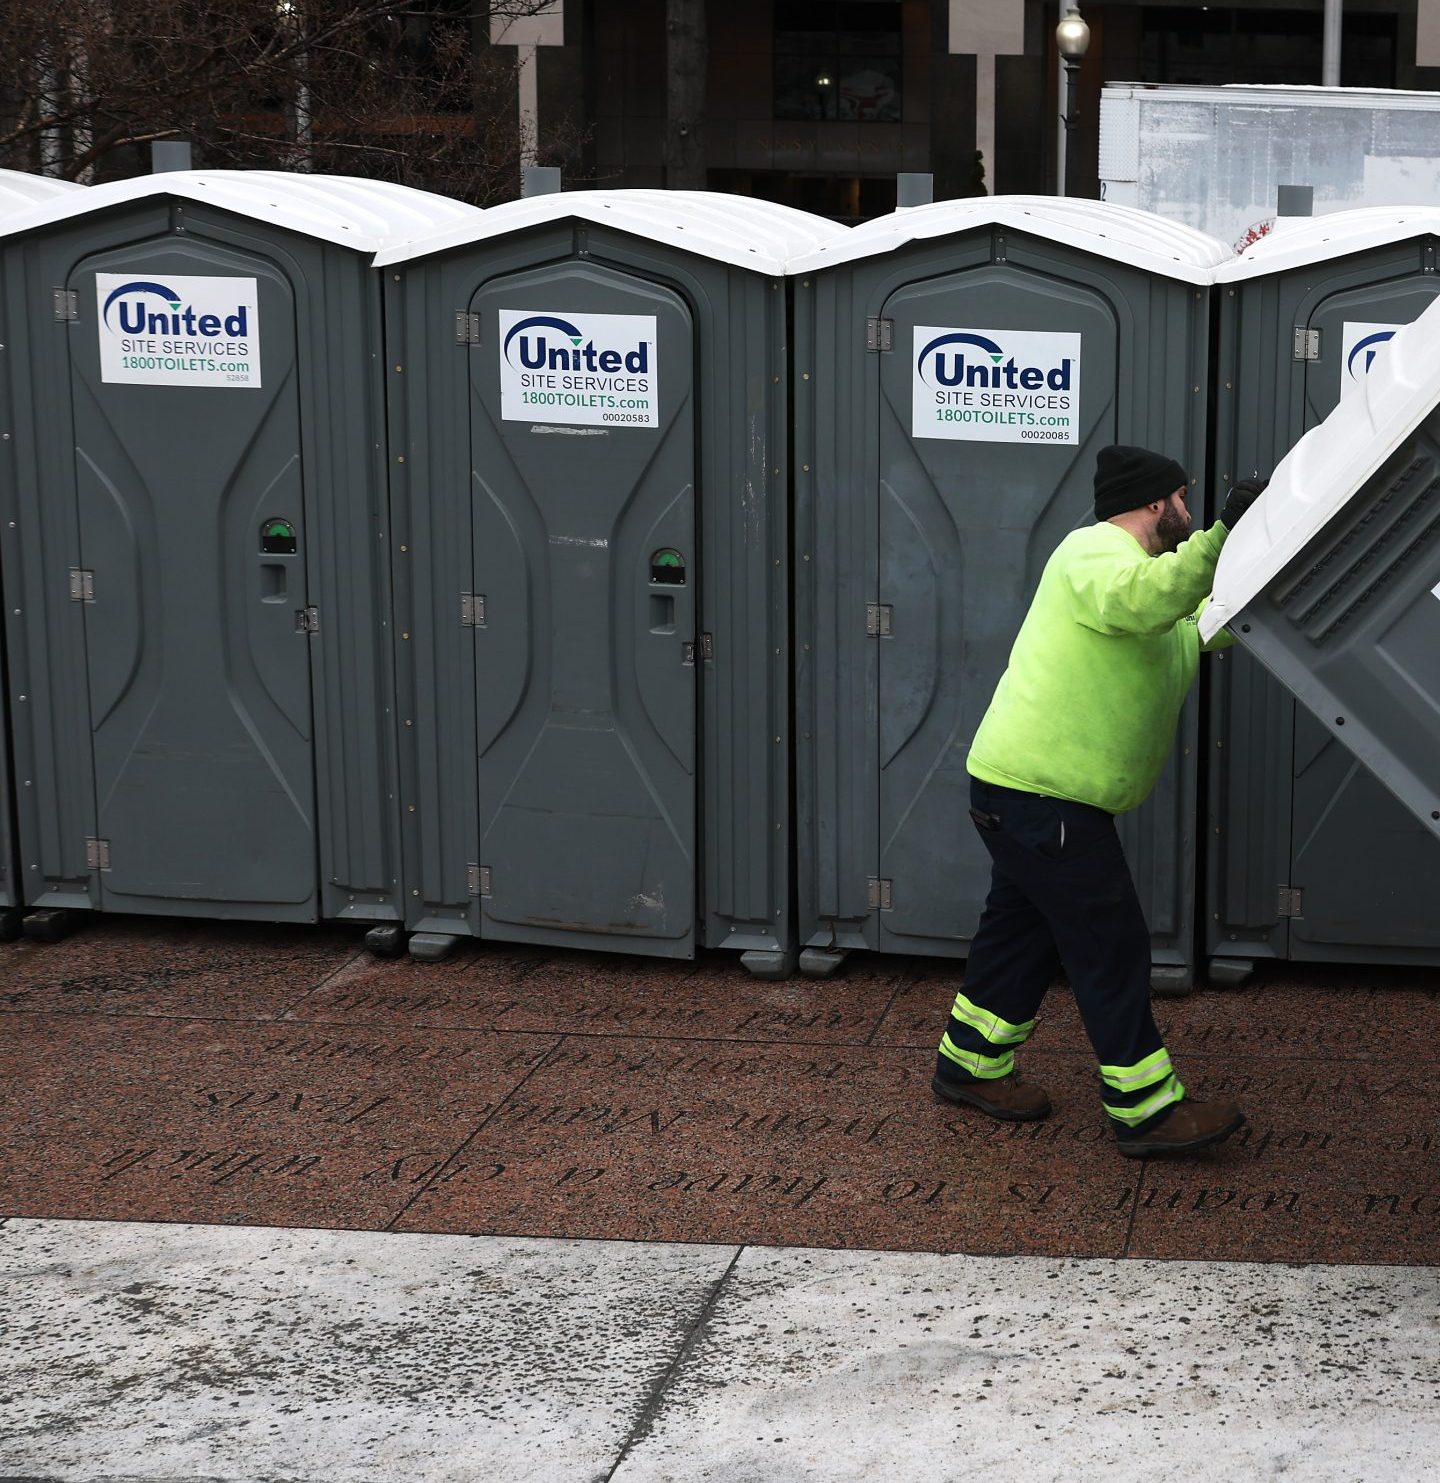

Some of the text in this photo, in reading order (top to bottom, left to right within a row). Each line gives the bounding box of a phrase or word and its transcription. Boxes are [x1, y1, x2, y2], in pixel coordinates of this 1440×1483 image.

[118, 301, 248, 337] United
[122, 339, 248, 356] SITE SERVICES
[519, 336, 648, 373] United
[122, 356, 249, 372] 1800TOILETS.com
[935, 353, 1071, 391] United
[521, 374, 649, 392] SITE SERVICES
[522, 392, 649, 409] 1800TOILETS.com
[935, 391, 1070, 409] SITE SERVICES
[602, 413, 650, 423] 00020583
[936, 409, 1070, 426] 1800TOILETS.com
[1021, 430, 1070, 440] 00020085
[724, 1111, 892, 1143] from
[944, 1122, 1108, 1144] omes
[553, 1166, 606, 1188] a
[647, 1171, 828, 1210] have
[881, 1180, 948, 1204] to
[1008, 1181, 1056, 1213] is
[1112, 1187, 1300, 1213] want
